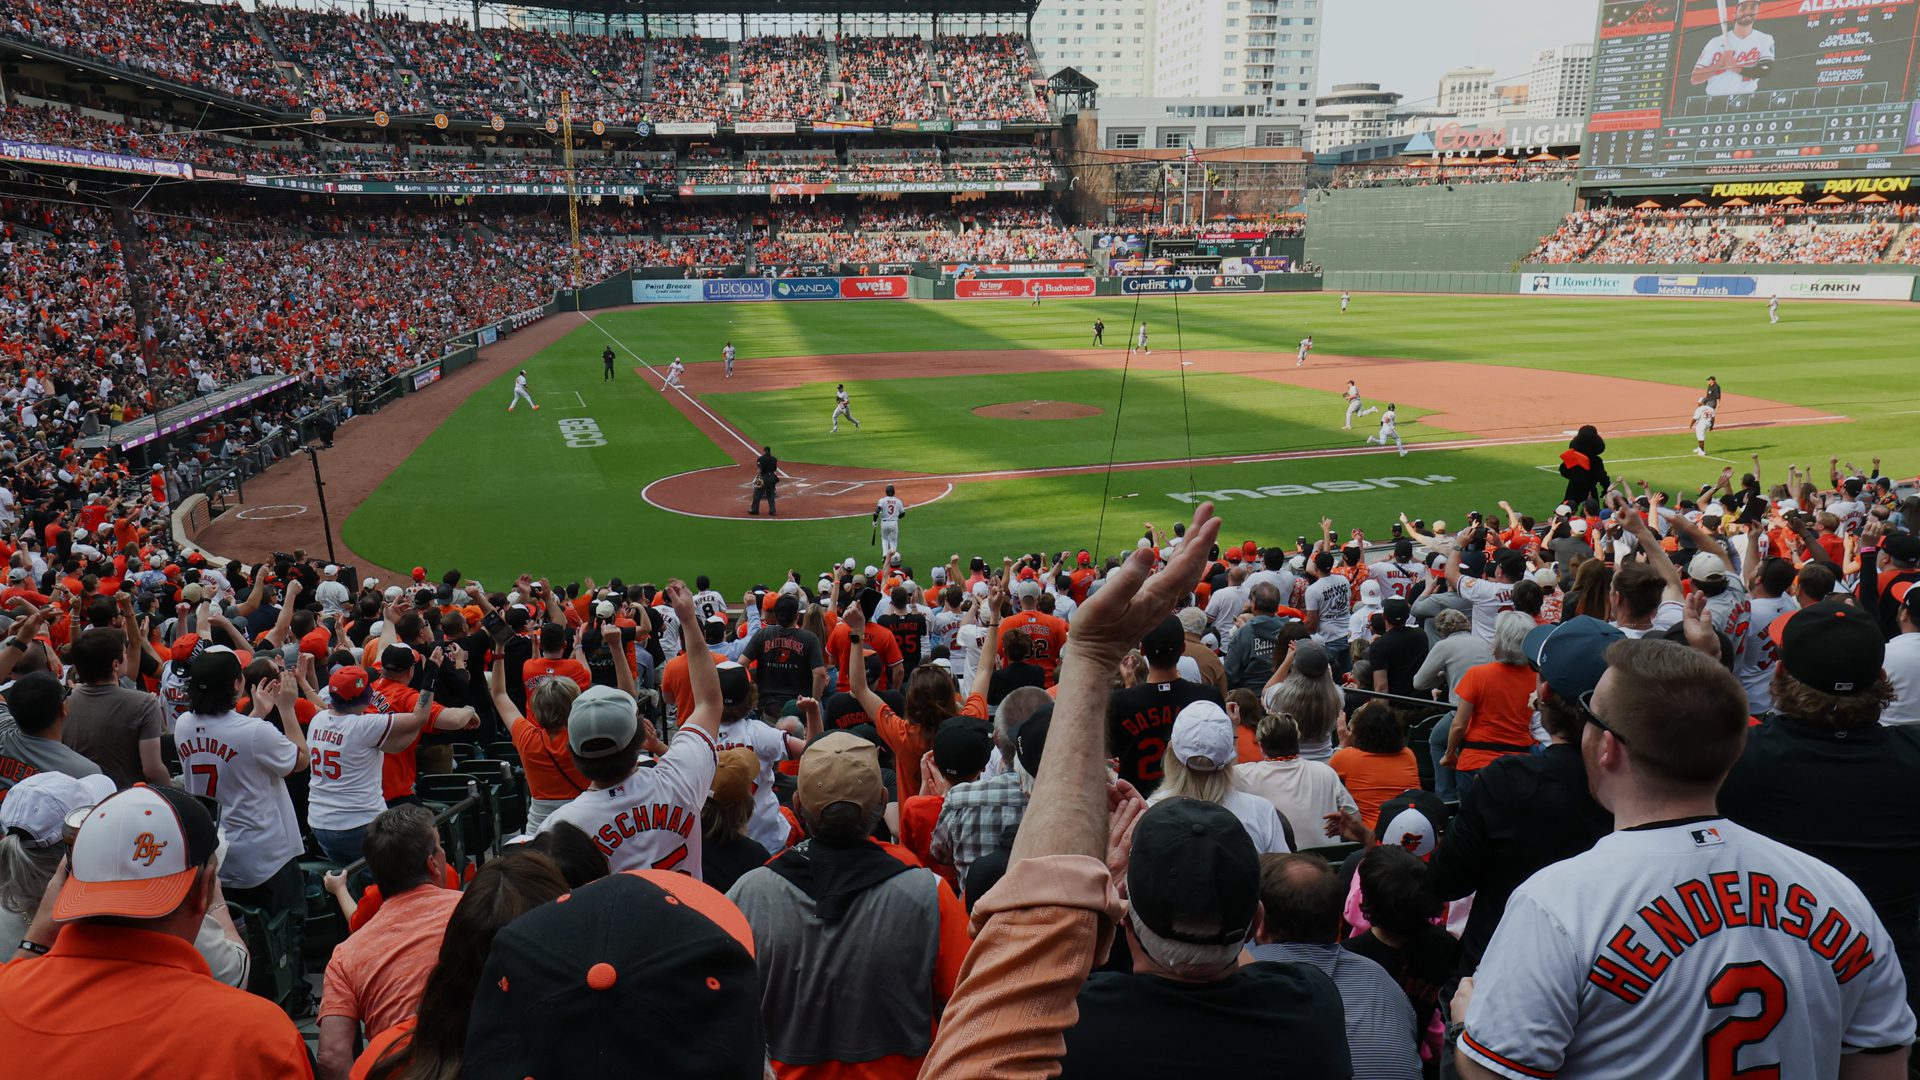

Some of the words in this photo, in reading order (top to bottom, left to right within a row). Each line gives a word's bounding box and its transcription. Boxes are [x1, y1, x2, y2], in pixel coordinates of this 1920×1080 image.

[1819, 40, 1838, 48] CAPE
[313, 112, 325, 121] 20
[437, 117, 444, 125] 4
[638, 126, 648, 135] 42
[1702, 126, 1709, 135] 0
[1714, 125, 1722, 134] 0
[1727, 125, 1735, 133] 0
[1742, 123, 1750, 132] 0
[1755, 123, 1763, 131] 0
[1769, 122, 1777, 130] 0
[1785, 121, 1793, 130] 0
[1830, 118, 1838, 127] 0
[1845, 117, 1852, 126] 3
[1861, 116, 1866, 125] 1
[1878, 115, 1886, 124] 4
[1893, 114, 1901, 123] 2
[1435, 122, 1507, 149] Coors
[1511, 123, 1585, 146] LIGHT
[1700, 139, 1707, 147] 0
[1712, 138, 1720, 147] 0
[1725, 138, 1733, 146] 0
[1740, 137, 1748, 145] 0
[1753, 136, 1761, 145] 0
[1767, 135, 1775, 144] 0
[1784, 134, 1789, 143] 1
[1830, 132, 1835, 140] 1
[1842, 131, 1850, 140] 3
[1859, 130, 1864, 139] 1
[1876, 129, 1884, 138] 3
[1893, 128, 1898, 137] 1
[3, 142, 20, 160] Pay
[21, 144, 42, 159] Tolls
[43, 147, 57, 161] the
[59, 150, 72, 163] E-Z
[73, 153, 91, 165] way.
[91, 153, 105, 167] Get
[105, 155, 117, 168] the
[118, 157, 132, 172] App
[132, 159, 154, 174] Today!
[1432, 150, 1482, 159] ROOF
[1498, 144, 1549, 156] DECK
[1706, 166, 1738, 175] ORIOLE
[1738, 165, 1760, 173] PARK
[1770, 163, 1808, 172] CAMDEN
[1809, 161, 1839, 170] YARDS
[394, 184, 409, 192] 94.6
[586, 186, 592, 194] 2
[612, 186, 617, 194] 2
[836, 184, 859, 192] Score
[860, 184, 875, 192] the
[937, 183, 957, 191] with
[957, 182, 990, 190] E-ZPass
[1711, 181, 1805, 197] PUREWAGER
[1823, 177, 1911, 194] PAVILION
[1009, 263, 1033, 272] BIRD
[1034, 263, 1058, 271] BATH
[790, 284, 833, 292] VANDA
[856, 279, 892, 291] weis
[1045, 284, 1090, 292] Budweiser
[1129, 280, 1168, 290] CareFirst
[1224, 277, 1246, 285] PNC
[1563, 277, 1592, 287] Rowe
[1593, 276, 1619, 287] Price
[1810, 283, 1860, 292] RANKIN
[709, 283, 764, 294] LECOM
[1658, 286, 1693, 295] MedStar
[1696, 286, 1728, 295] Health
[1166, 476, 1434, 503] masn
[888, 504, 895, 515] 3
[702, 605, 714, 619] 8
[889, 623, 918, 632] ALONSO
[765, 637, 804, 655] BALTIMORE
[1122, 705, 1180, 736] BASA
[312, 728, 344, 746] ALONSO
[178, 737, 238, 764] HOLLIDAY
[311, 747, 342, 781] 25
[1137, 737, 1166, 781] 2
[191, 764, 218, 798] 7
[591, 803, 696, 857] TSCHMAN
[132, 832, 168, 867] BF
[1587, 870, 1875, 1005] HENDERSON
[1703, 959, 1788, 1080] 2
